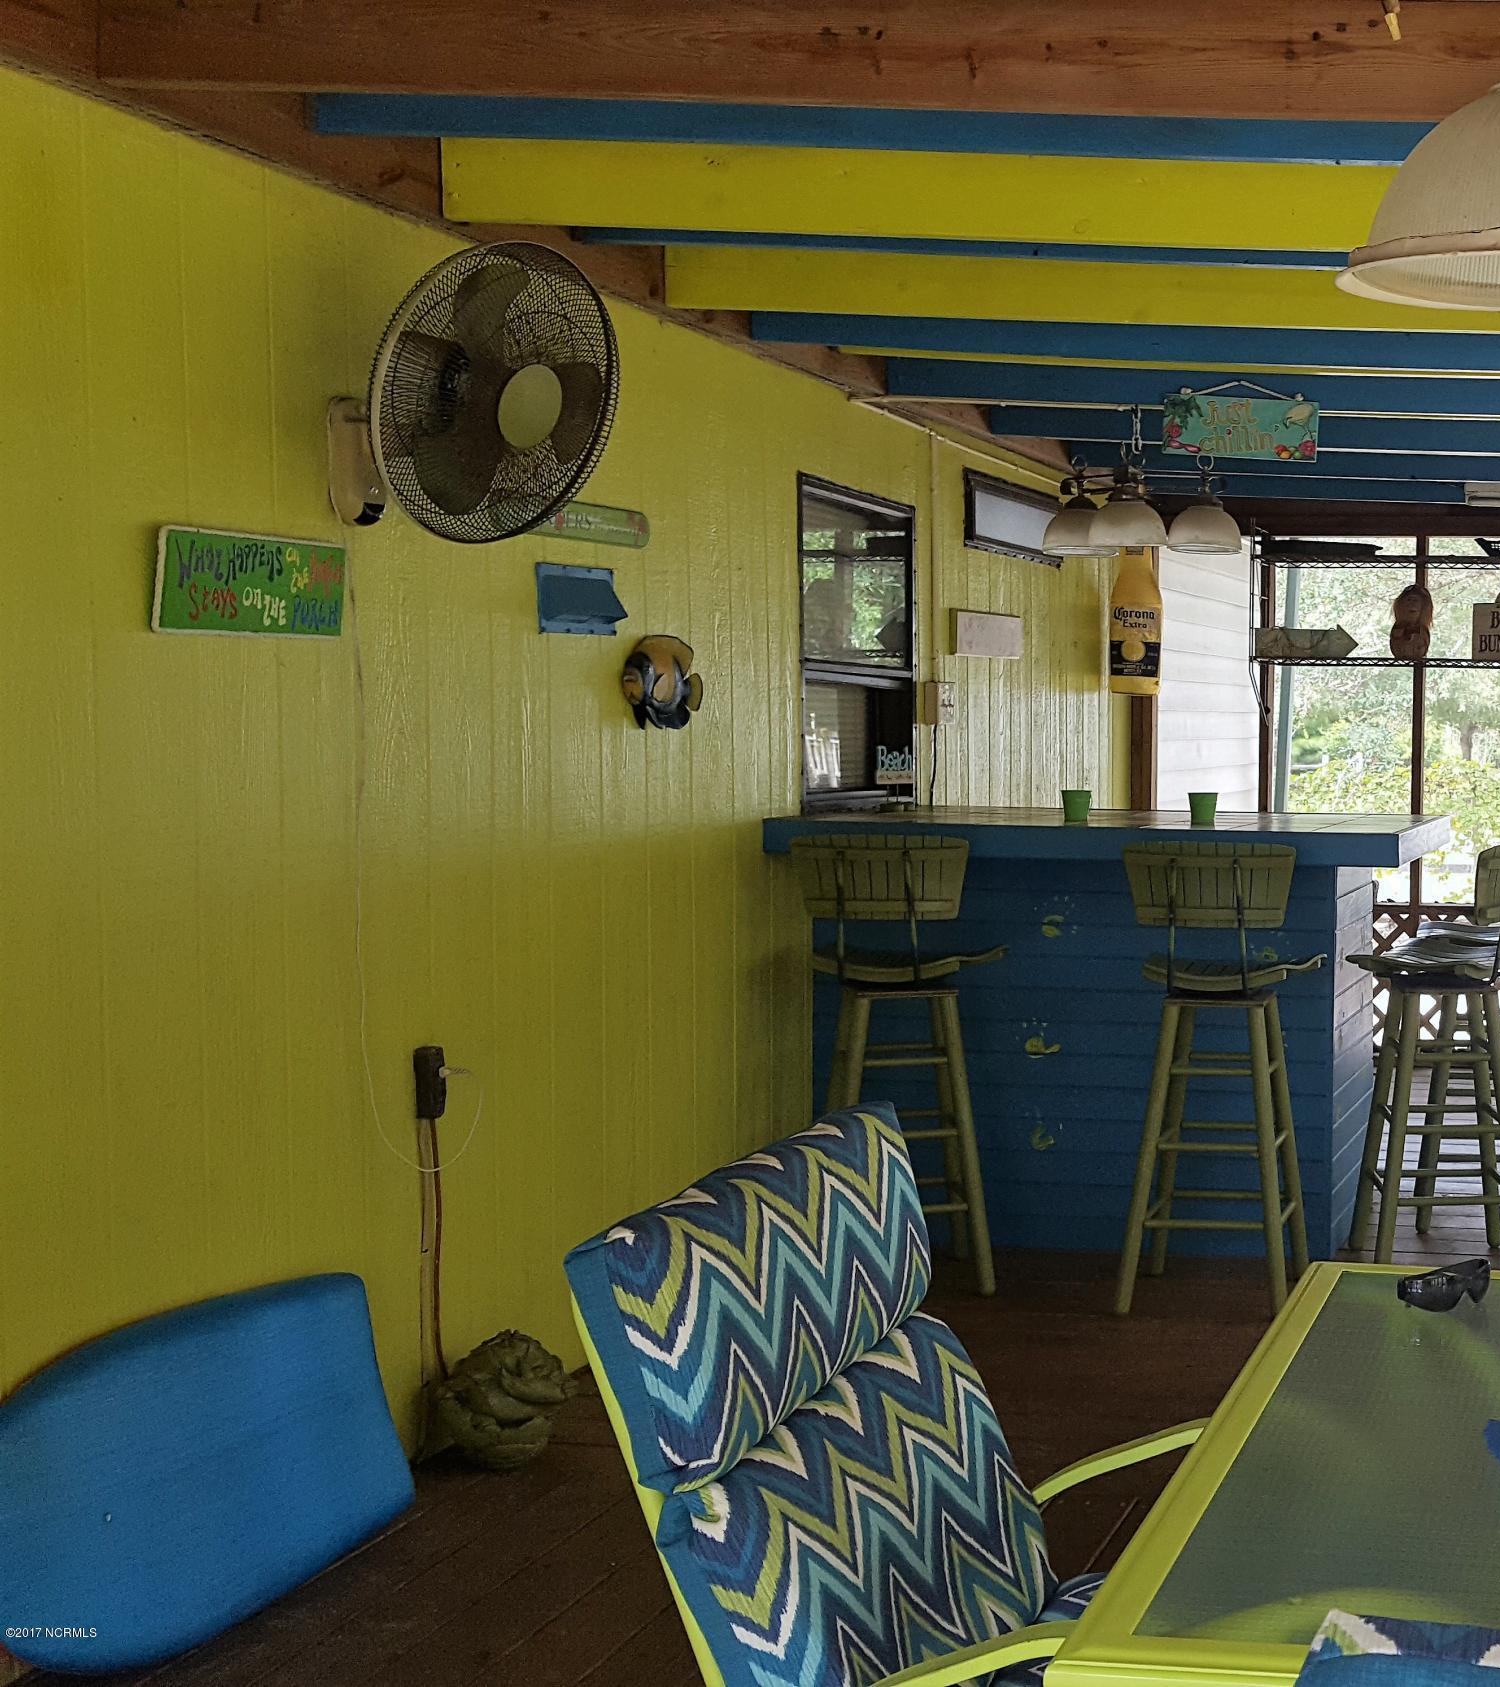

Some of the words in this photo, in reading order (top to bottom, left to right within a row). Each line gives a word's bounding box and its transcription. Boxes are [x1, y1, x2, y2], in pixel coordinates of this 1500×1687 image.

[1113, 606, 1155, 621] Corona
[1122, 619, 1147, 629] Extra
[876, 745, 912, 771] Beach
